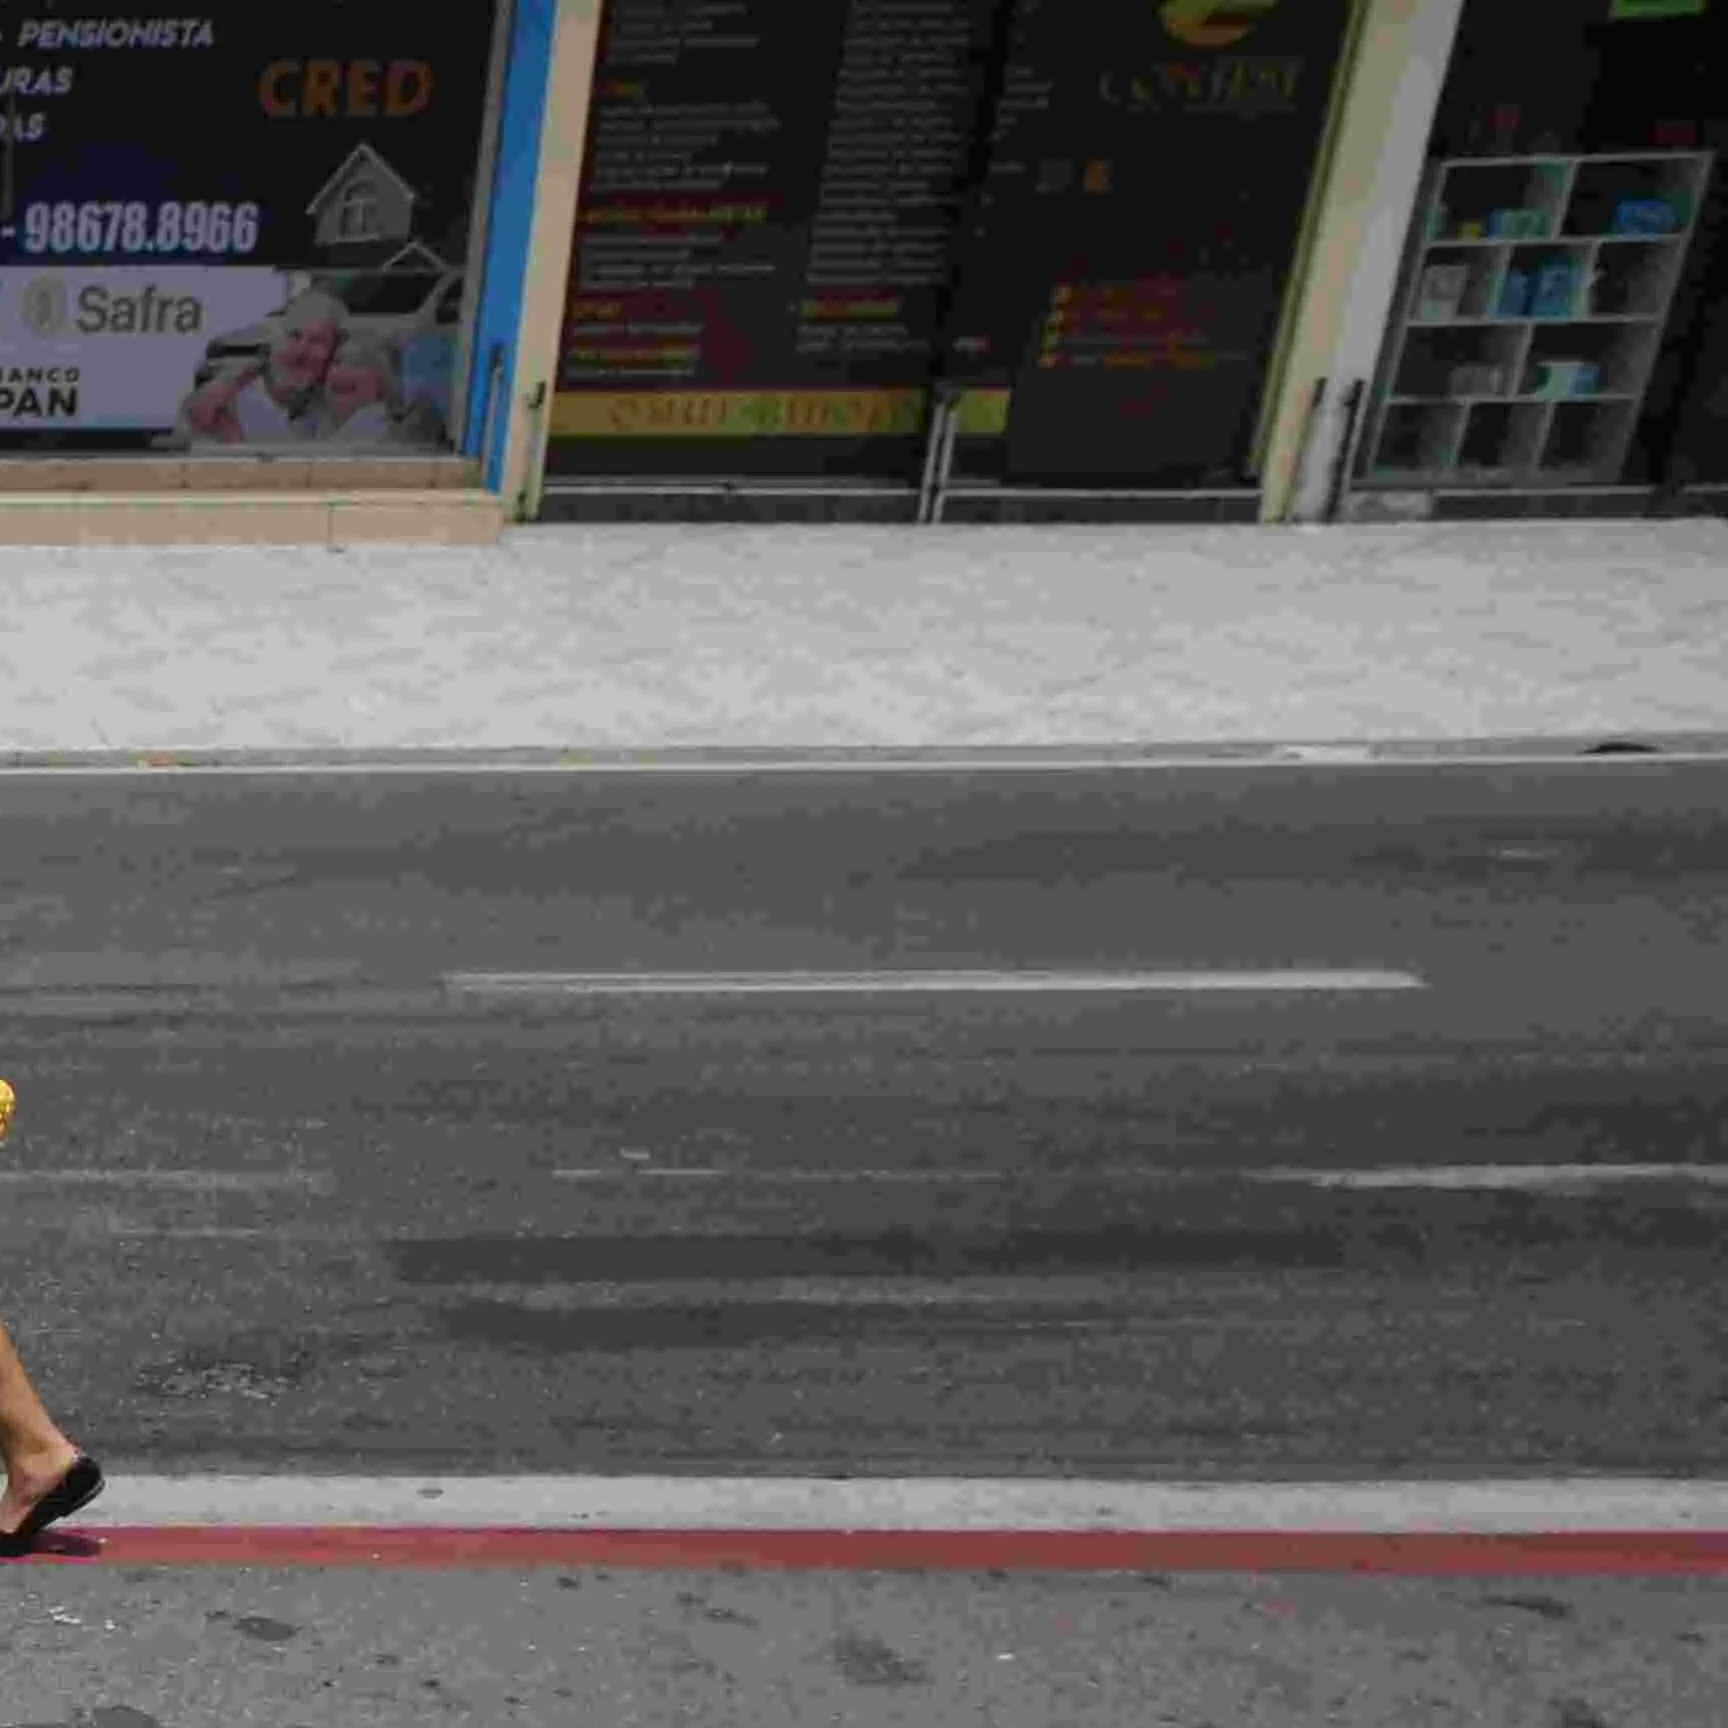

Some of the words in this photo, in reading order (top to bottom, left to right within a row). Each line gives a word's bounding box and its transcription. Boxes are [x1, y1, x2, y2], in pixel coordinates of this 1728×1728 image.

[16, 17, 214, 49] PENSIONISTA
[259, 58, 433, 117] CRED
[25, 201, 258, 253] 98678.8966
[75, 285, 204, 334] Safra
